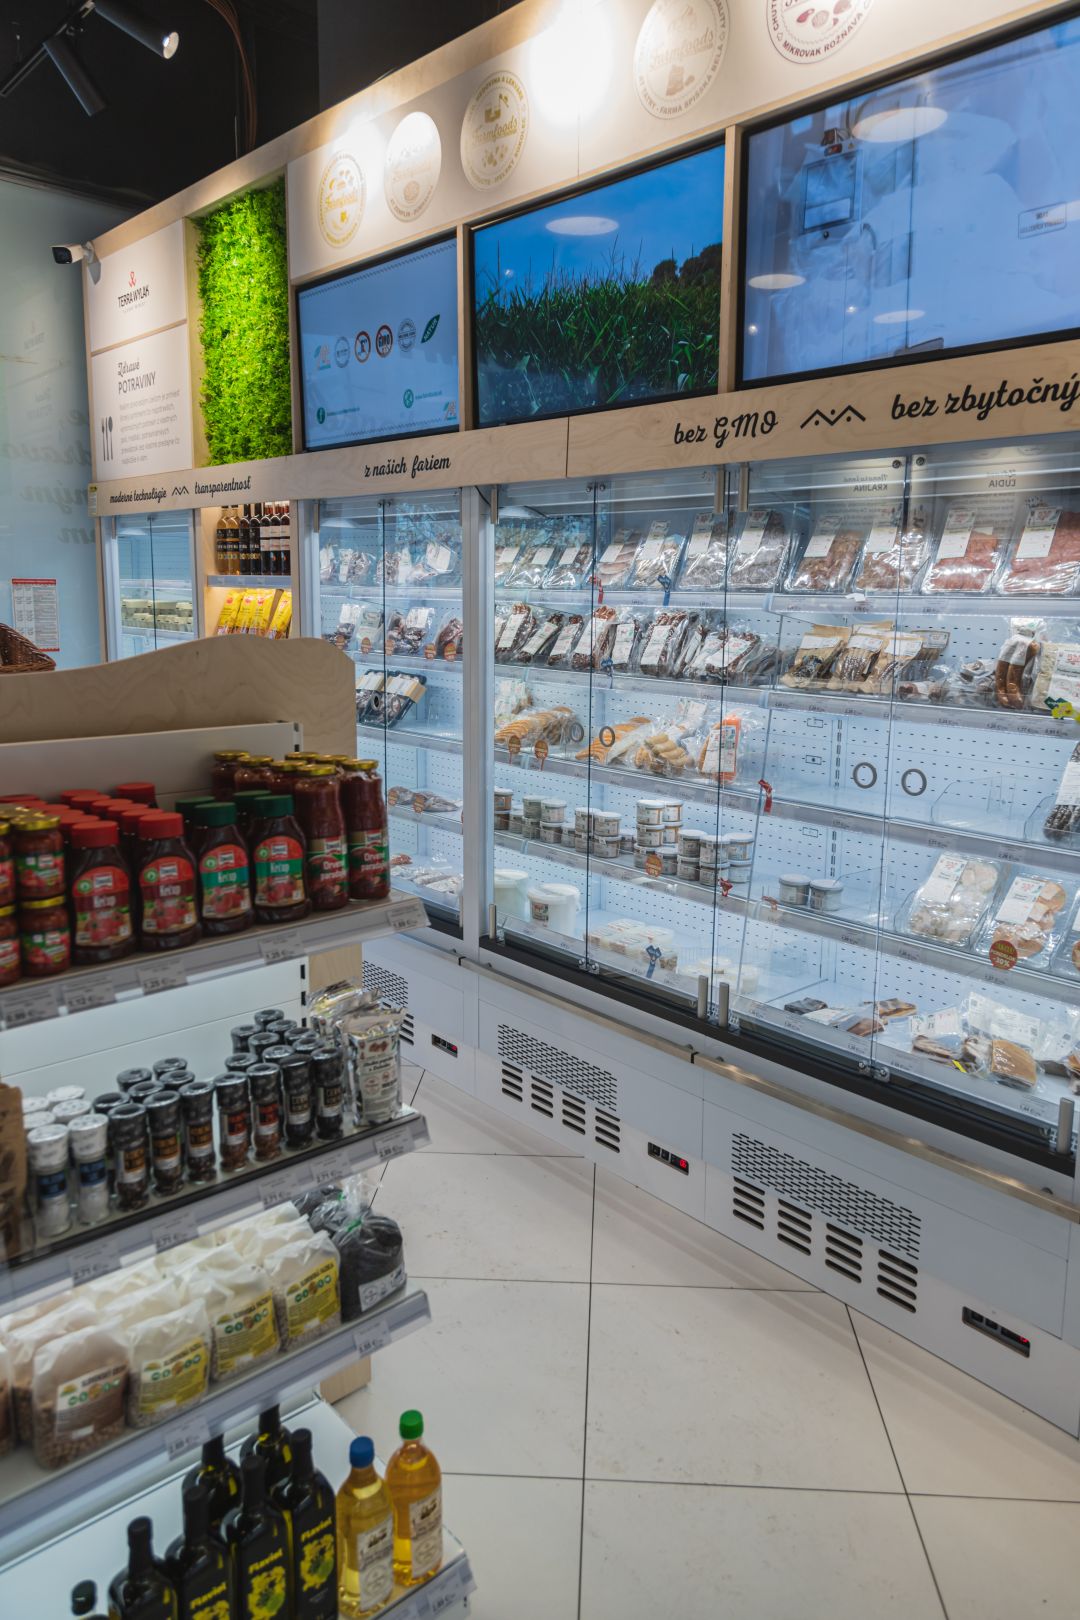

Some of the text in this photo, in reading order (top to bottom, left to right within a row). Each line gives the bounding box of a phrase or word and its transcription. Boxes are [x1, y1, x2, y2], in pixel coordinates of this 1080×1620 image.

[782, 40, 822, 57] MIKROVAK
[118, 371, 156, 394] POTRAVINY
[891, 393, 938, 420] bez
[674, 410, 778, 449] bez GMO
[365, 455, 451, 479] z našich fariem
